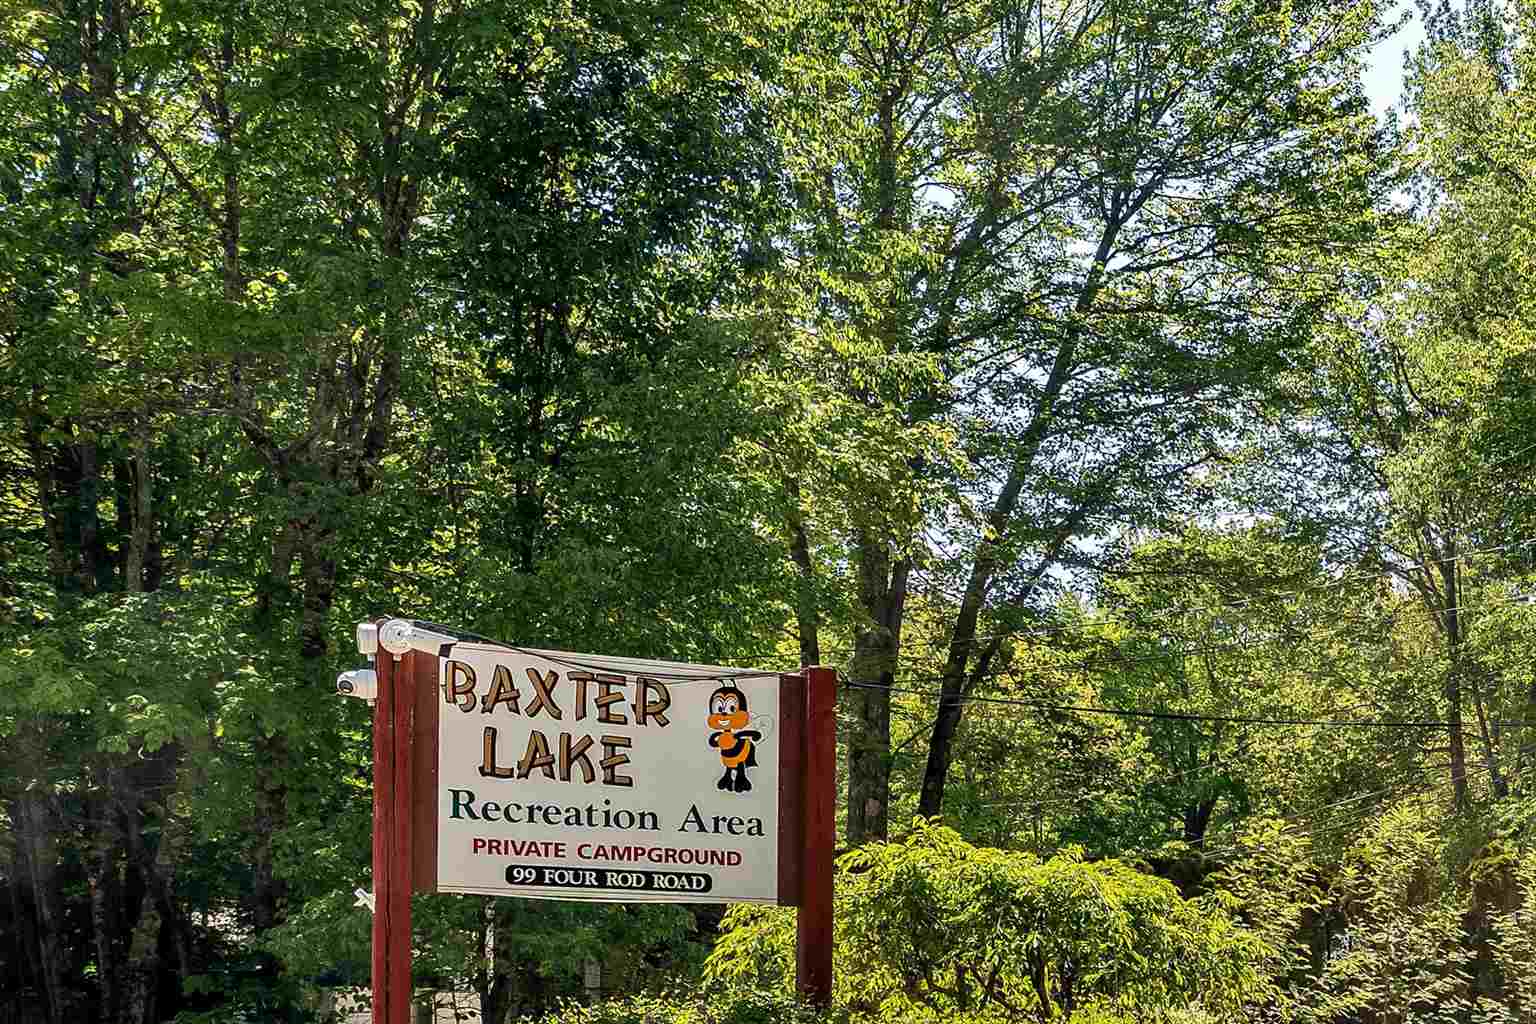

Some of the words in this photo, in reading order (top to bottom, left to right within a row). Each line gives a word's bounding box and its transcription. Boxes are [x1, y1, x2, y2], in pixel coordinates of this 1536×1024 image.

[442, 660, 671, 727] BAXTER
[478, 726, 633, 787] LAKE
[448, 788, 661, 831] Recreation
[678, 803, 766, 837] Area
[472, 837, 567, 859] PRIVATE
[577, 843, 742, 866] CAMPGROUND
[512, 867, 537, 883] 99
[543, 869, 597, 887] FOUR
[606, 871, 646, 888] ROD
[652, 873, 706, 891] ROAD
